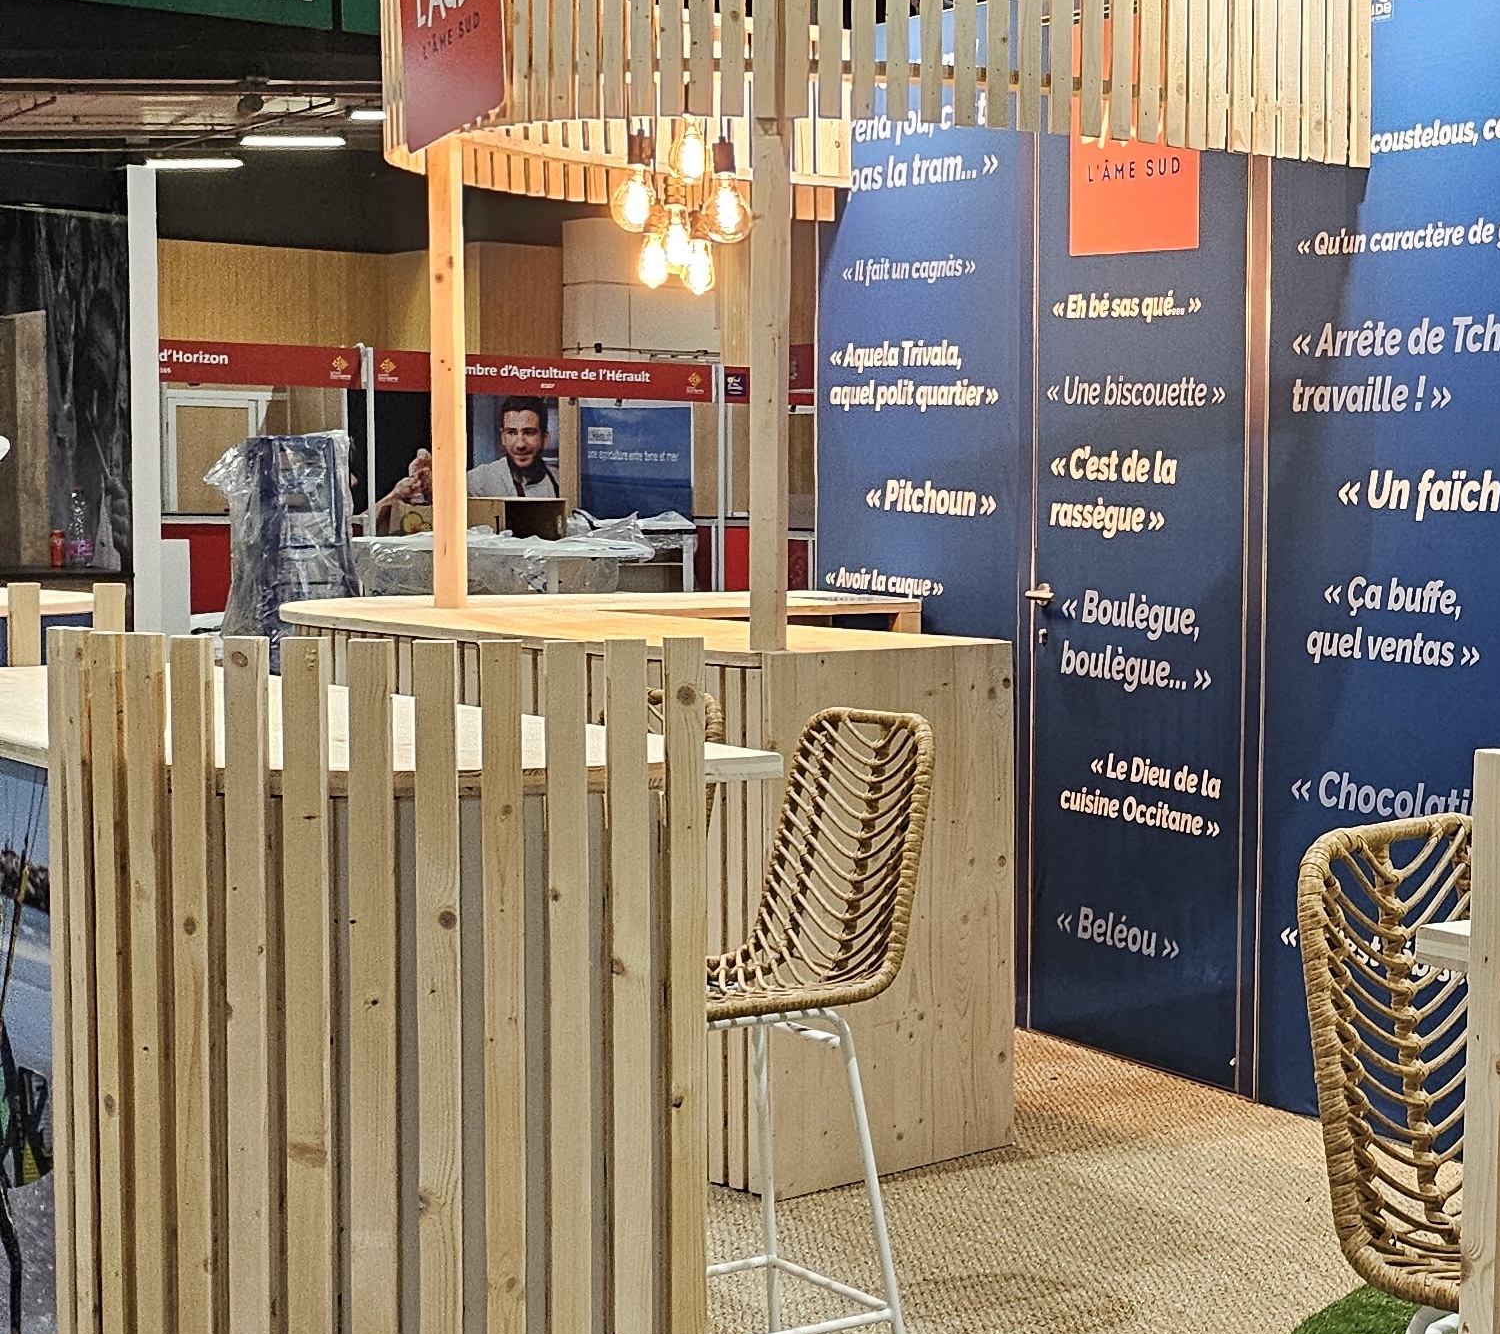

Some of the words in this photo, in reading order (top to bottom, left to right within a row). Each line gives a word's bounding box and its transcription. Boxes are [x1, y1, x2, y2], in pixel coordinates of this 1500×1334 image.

[458, 11, 480, 39] SUD
[886, 155, 908, 188] la
[912, 153, 977, 186] tram...
[1086, 158, 1136, 183] L'ÂME
[1145, 155, 1182, 177] SUD
[1314, 230, 1366, 257] Qu'un
[1370, 220, 1464, 254] caractère
[1467, 217, 1493, 247] de
[854, 260, 864, 282] Il
[865, 257, 890, 287] fait
[892, 261, 909, 280] un
[1066, 293, 1087, 319] Eh
[1088, 292, 1110, 319] bé
[1110, 296, 1140, 318] sas
[843, 340, 899, 374] Aquela
[901, 339, 962, 370] Trivala,
[1315, 321, 1401, 358] Arrête
[1407, 319, 1444, 356] de
[500, 365, 578, 381] d'Agriculture
[581, 369, 596, 380] de
[599, 368, 651, 383] l'Hérault
[1063, 375, 1101, 406] Une
[1104, 375, 1208, 407] biscouette
[829, 380, 875, 412] aquel
[916, 379, 984, 413] quartier
[1292, 376, 1408, 413] travaille
[1069, 445, 1119, 482] C'est
[1121, 449, 1151, 483] de
[1153, 450, 1178, 485] la
[884, 479, 977, 518] Pitchoun
[1367, 474, 1413, 510] Un
[836, 566, 871, 590] Avoir
[871, 569, 886, 592] la
[1081, 589, 1200, 642] Boulègue,
[1346, 575, 1383, 617] Ça
[1387, 578, 1462, 620] buffe,
[1306, 627, 1361, 665] quel
[1367, 628, 1455, 666] ventas
[1106, 752, 1126, 780] Le
[1130, 758, 1170, 790] Dieu
[1173, 764, 1198, 794] de
[1200, 770, 1221, 799] la
[1060, 787, 1119, 819] cuisine
[1123, 801, 1203, 836] Occitane
[1077, 905, 1158, 957] Beléou
